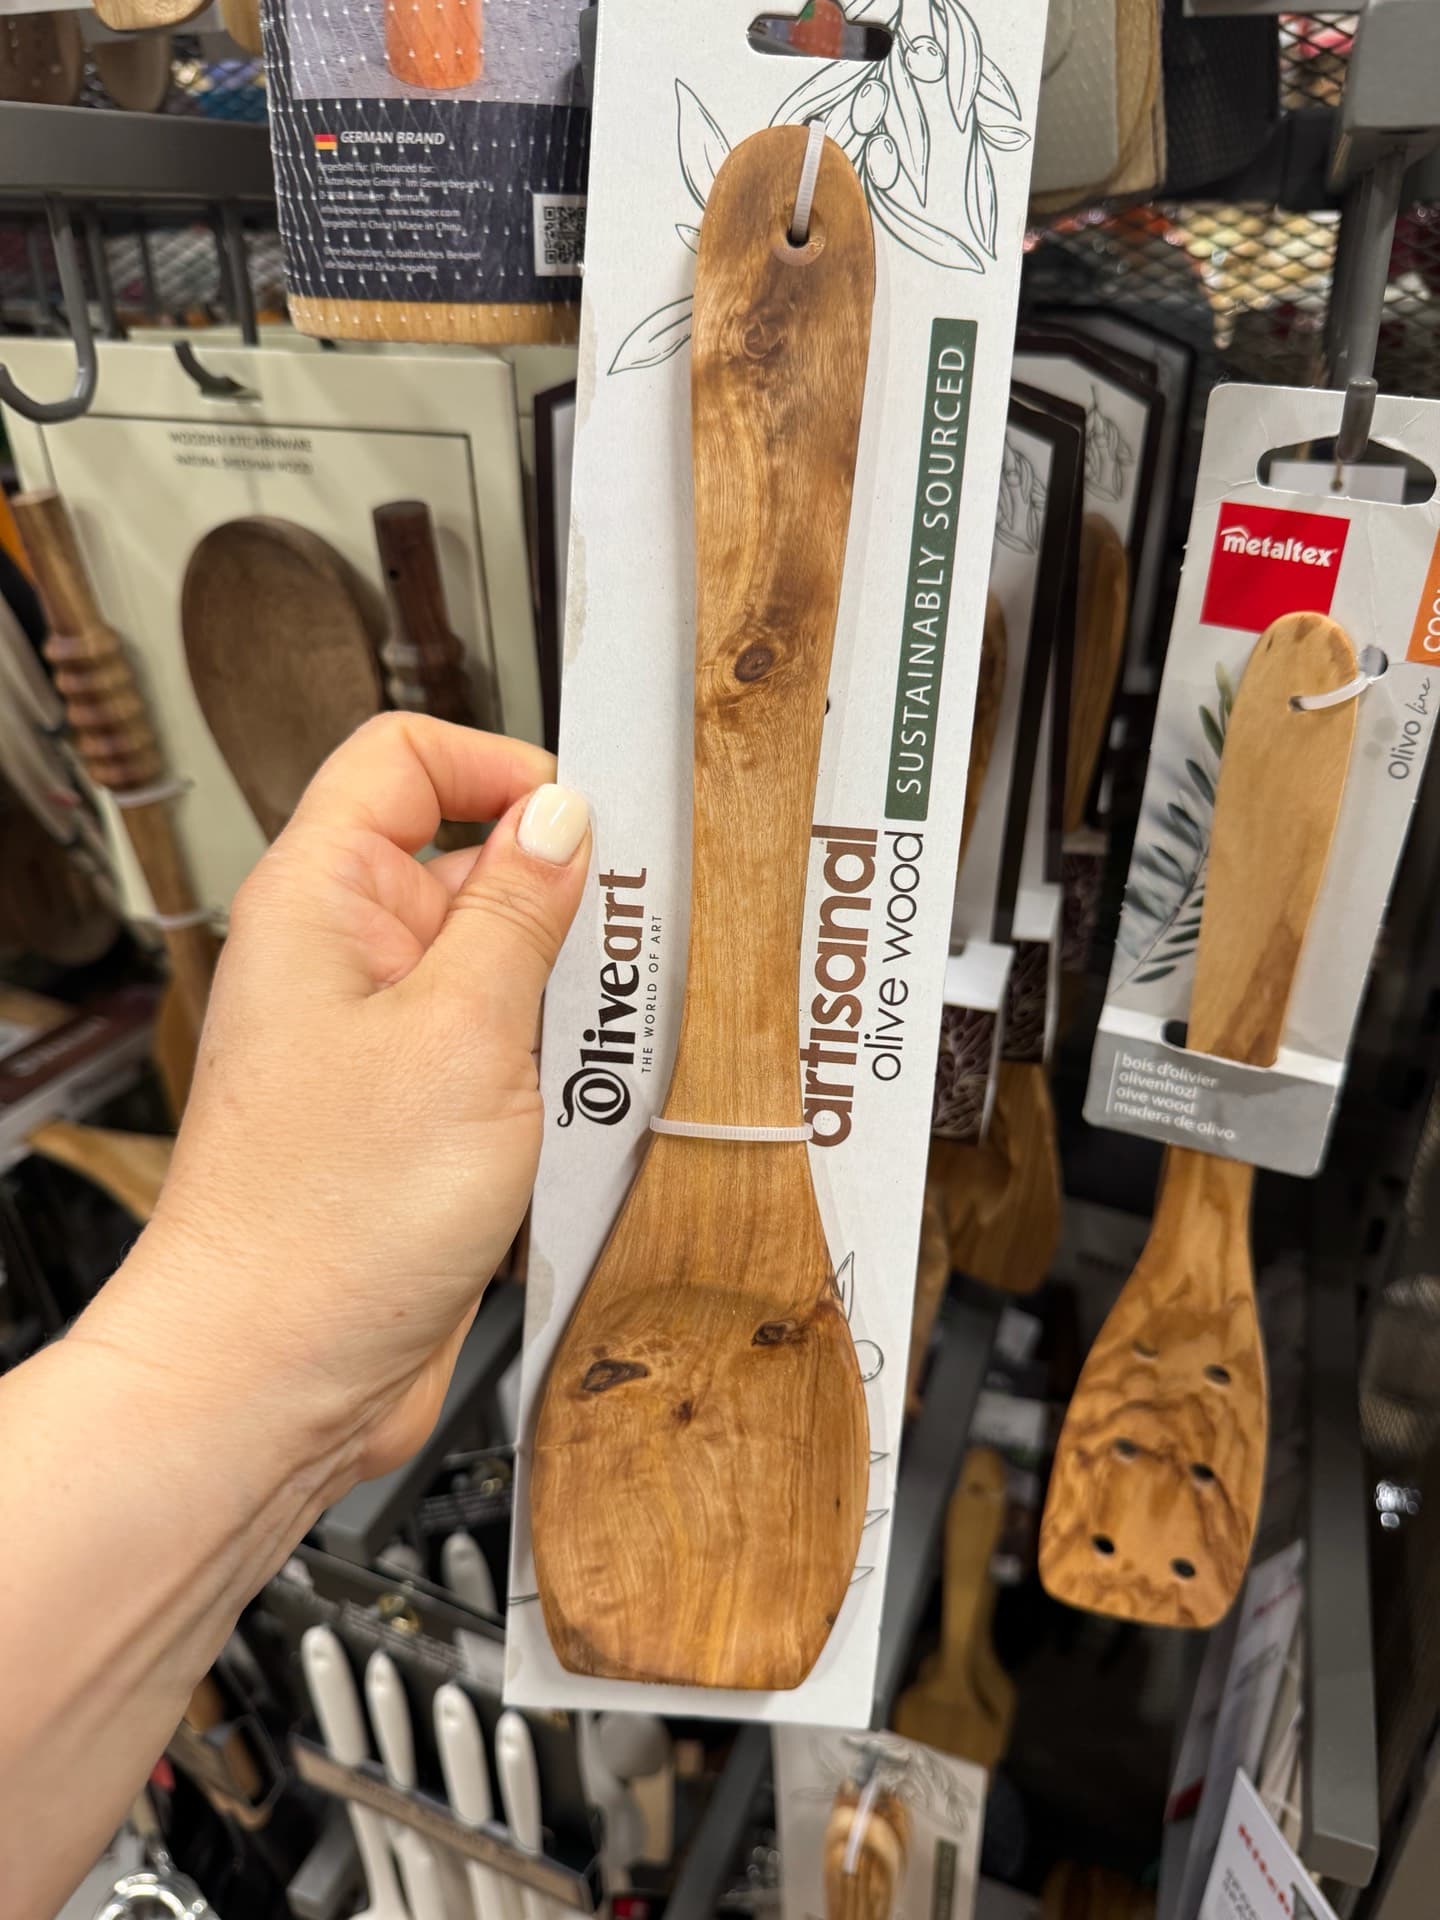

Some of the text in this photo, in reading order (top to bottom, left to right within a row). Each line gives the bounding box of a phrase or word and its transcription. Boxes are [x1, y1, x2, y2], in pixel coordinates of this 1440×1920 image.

[340, 131, 446, 145] GERMAN BRAND
[896, 346, 967, 796] SUSTAINABLY SOURCED
[1221, 527, 1333, 568] metaltex
[1387, 720, 1422, 780] Olivo
[800, 824, 878, 1147] artisanal
[863, 830, 924, 1081] olive wood
[557, 867, 647, 1127] Oliveart
[641, 914, 663, 1074] THE WORLD OF ART
[1121, 1053, 1154, 1073] bois
[1113, 1100, 1237, 1141] madera de olivo
[1151, 1095, 1196, 1116] wood
